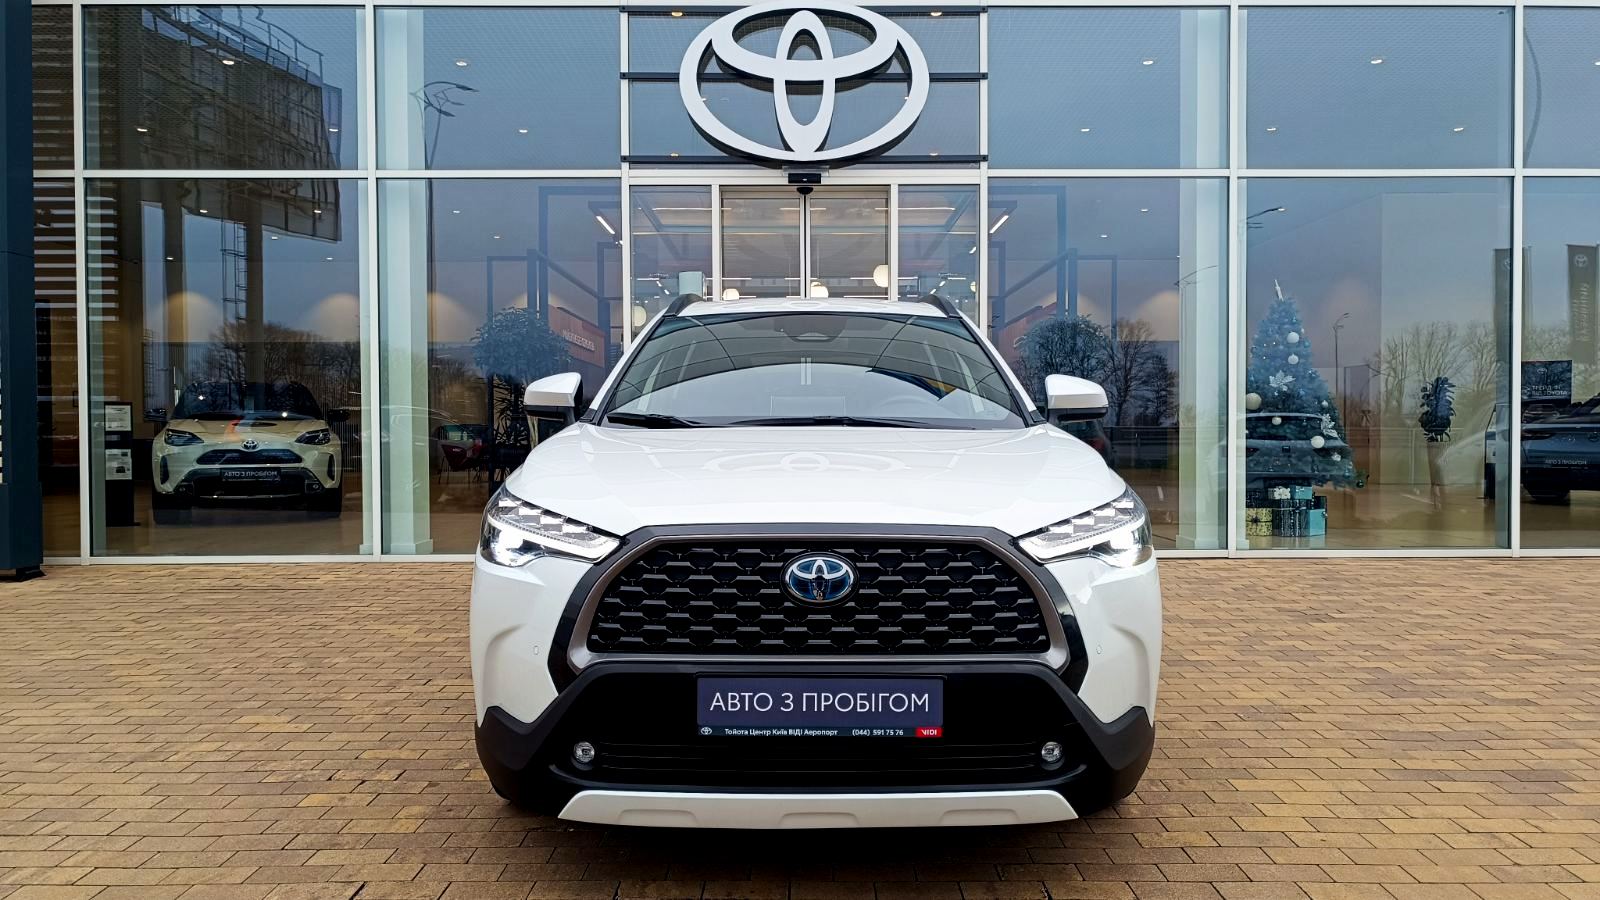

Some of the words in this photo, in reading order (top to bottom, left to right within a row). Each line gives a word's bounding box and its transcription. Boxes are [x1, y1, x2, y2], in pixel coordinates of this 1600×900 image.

[709, 692, 773, 712] АВТО
[780, 692, 794, 712] З
[802, 692, 929, 713] ПРОБІГОМ
[749, 728, 771, 736] Центр
[852, 728, 871, 736] (044)
